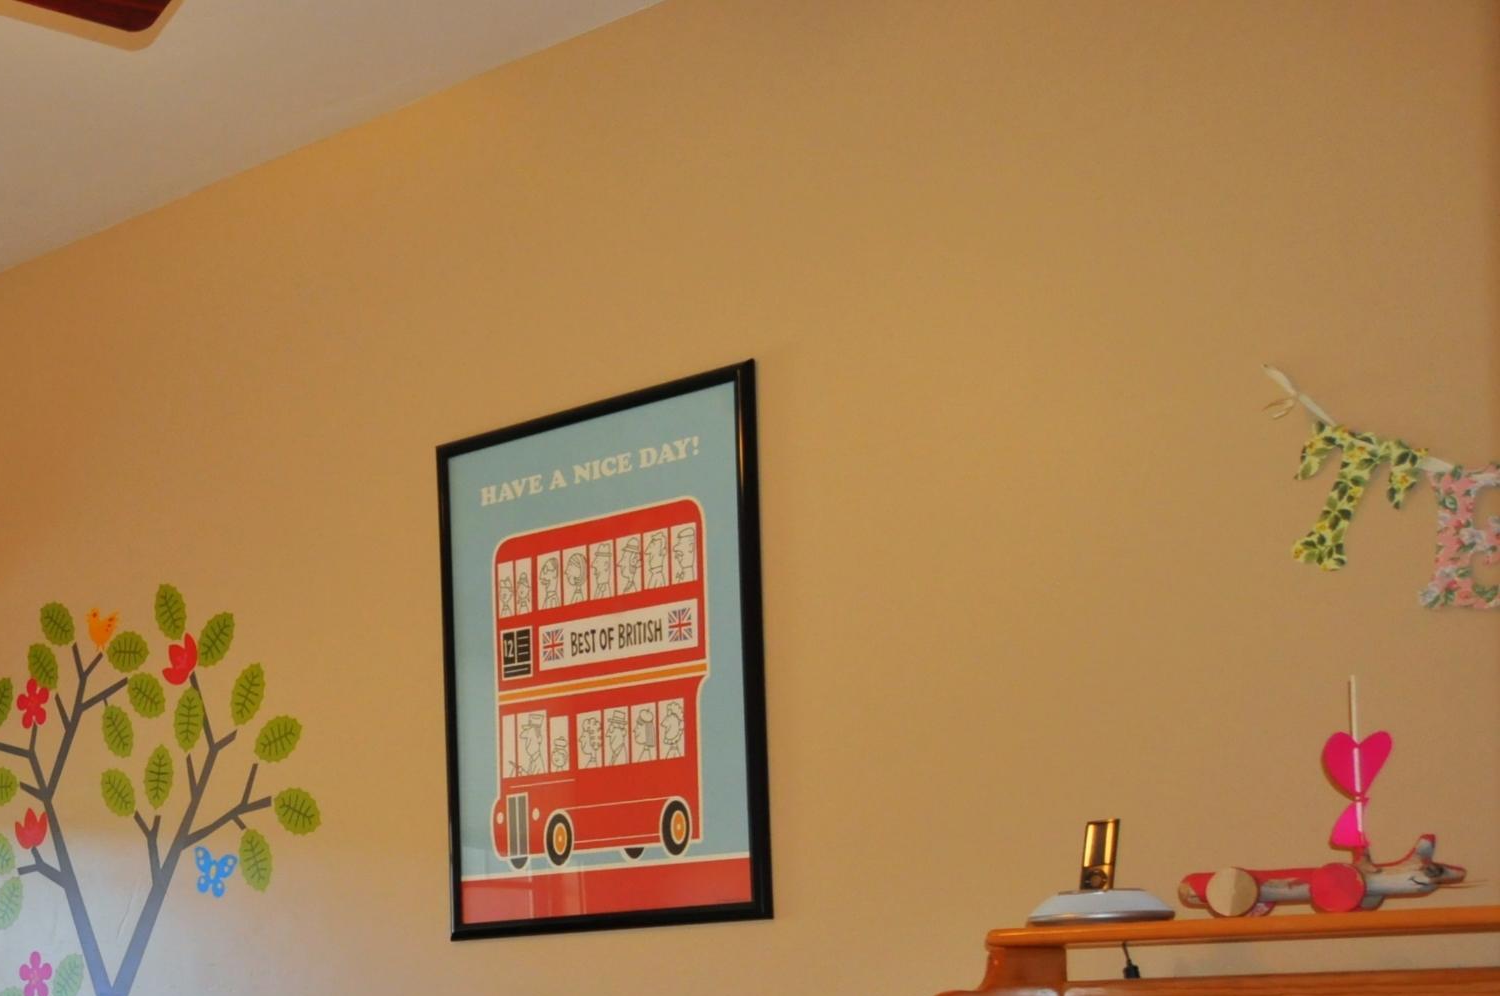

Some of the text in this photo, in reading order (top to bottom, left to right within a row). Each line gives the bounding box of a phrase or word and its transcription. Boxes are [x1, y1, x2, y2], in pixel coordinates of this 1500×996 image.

[480, 436, 700, 507] HAVE A NICE DAY!
[503, 638, 515, 659] 12
[570, 618, 663, 657] BEST OF BRITISH
